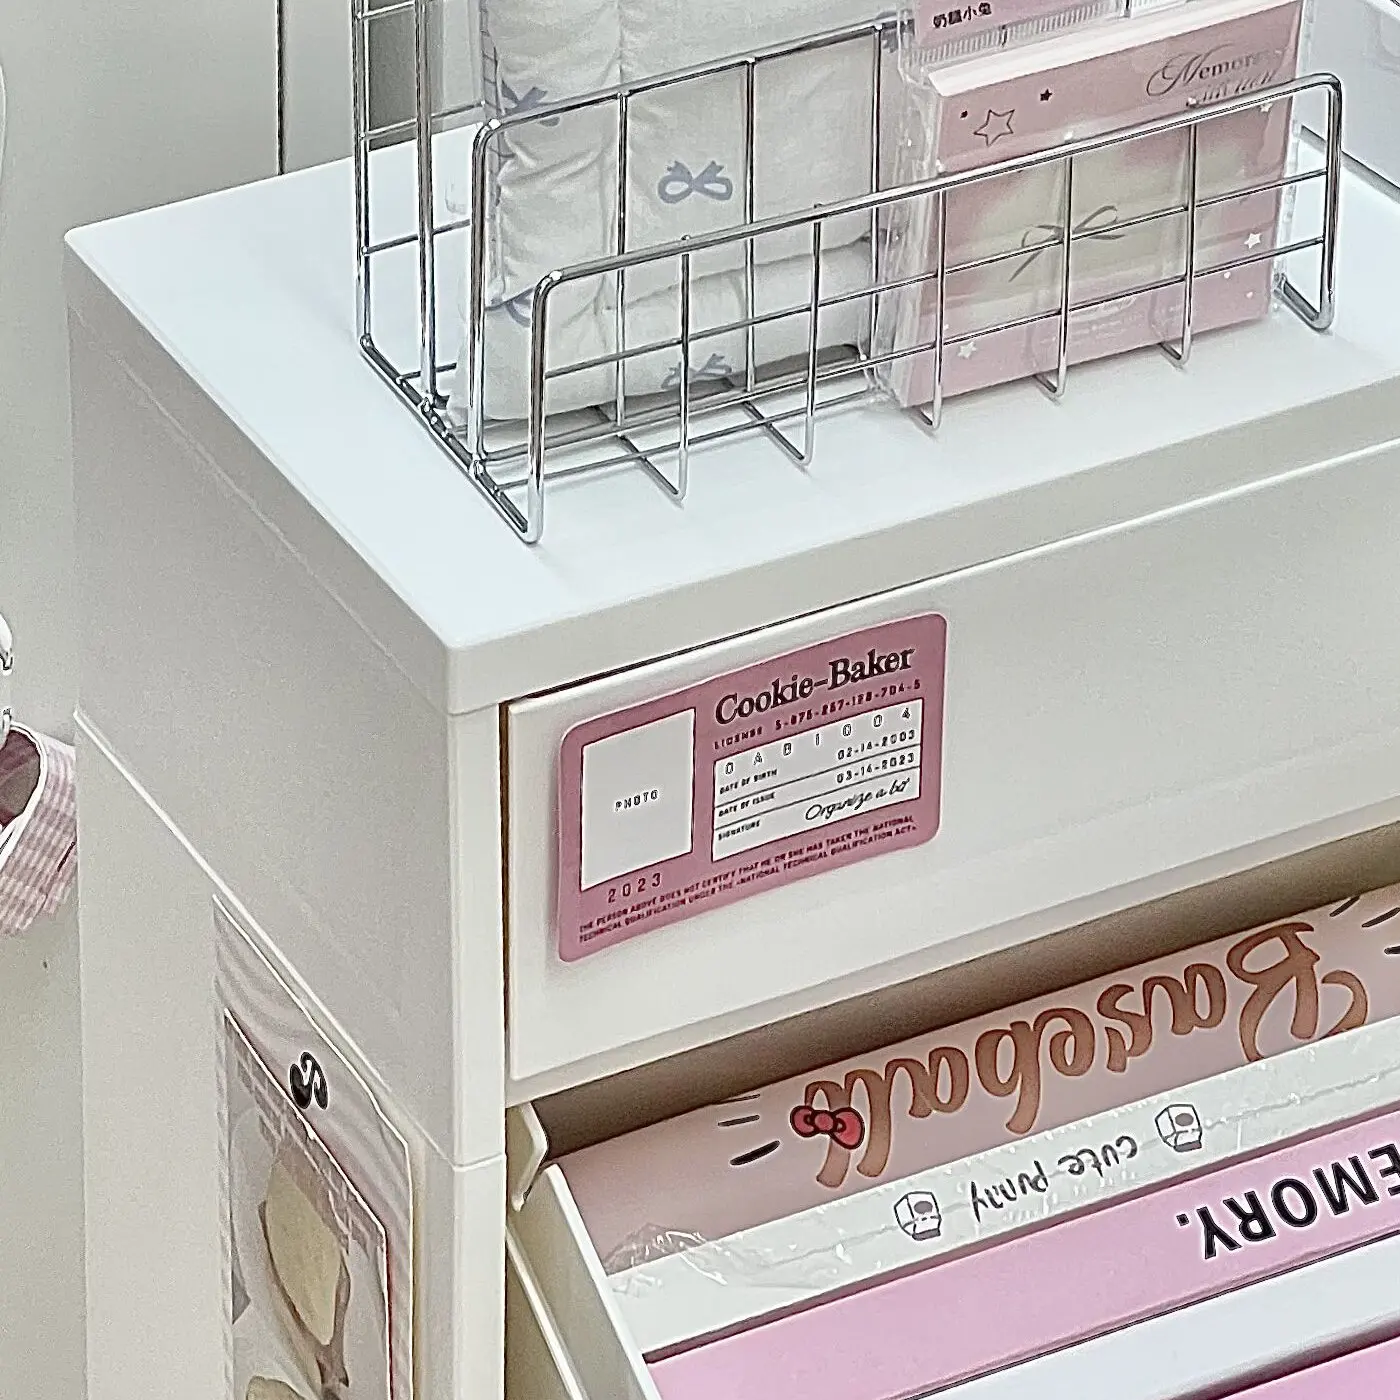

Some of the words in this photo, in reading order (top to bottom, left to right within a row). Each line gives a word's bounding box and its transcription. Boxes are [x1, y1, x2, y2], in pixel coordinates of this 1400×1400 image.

[715, 648, 916, 725] Cookie-Baker
[614, 789, 659, 813] PHOTO
[717, 819, 761, 841] SIGNATURE
[608, 872, 662, 904] 2023
[804, 921, 1369, 1189] Baseball
[1057, 1134, 1139, 1178] cute
